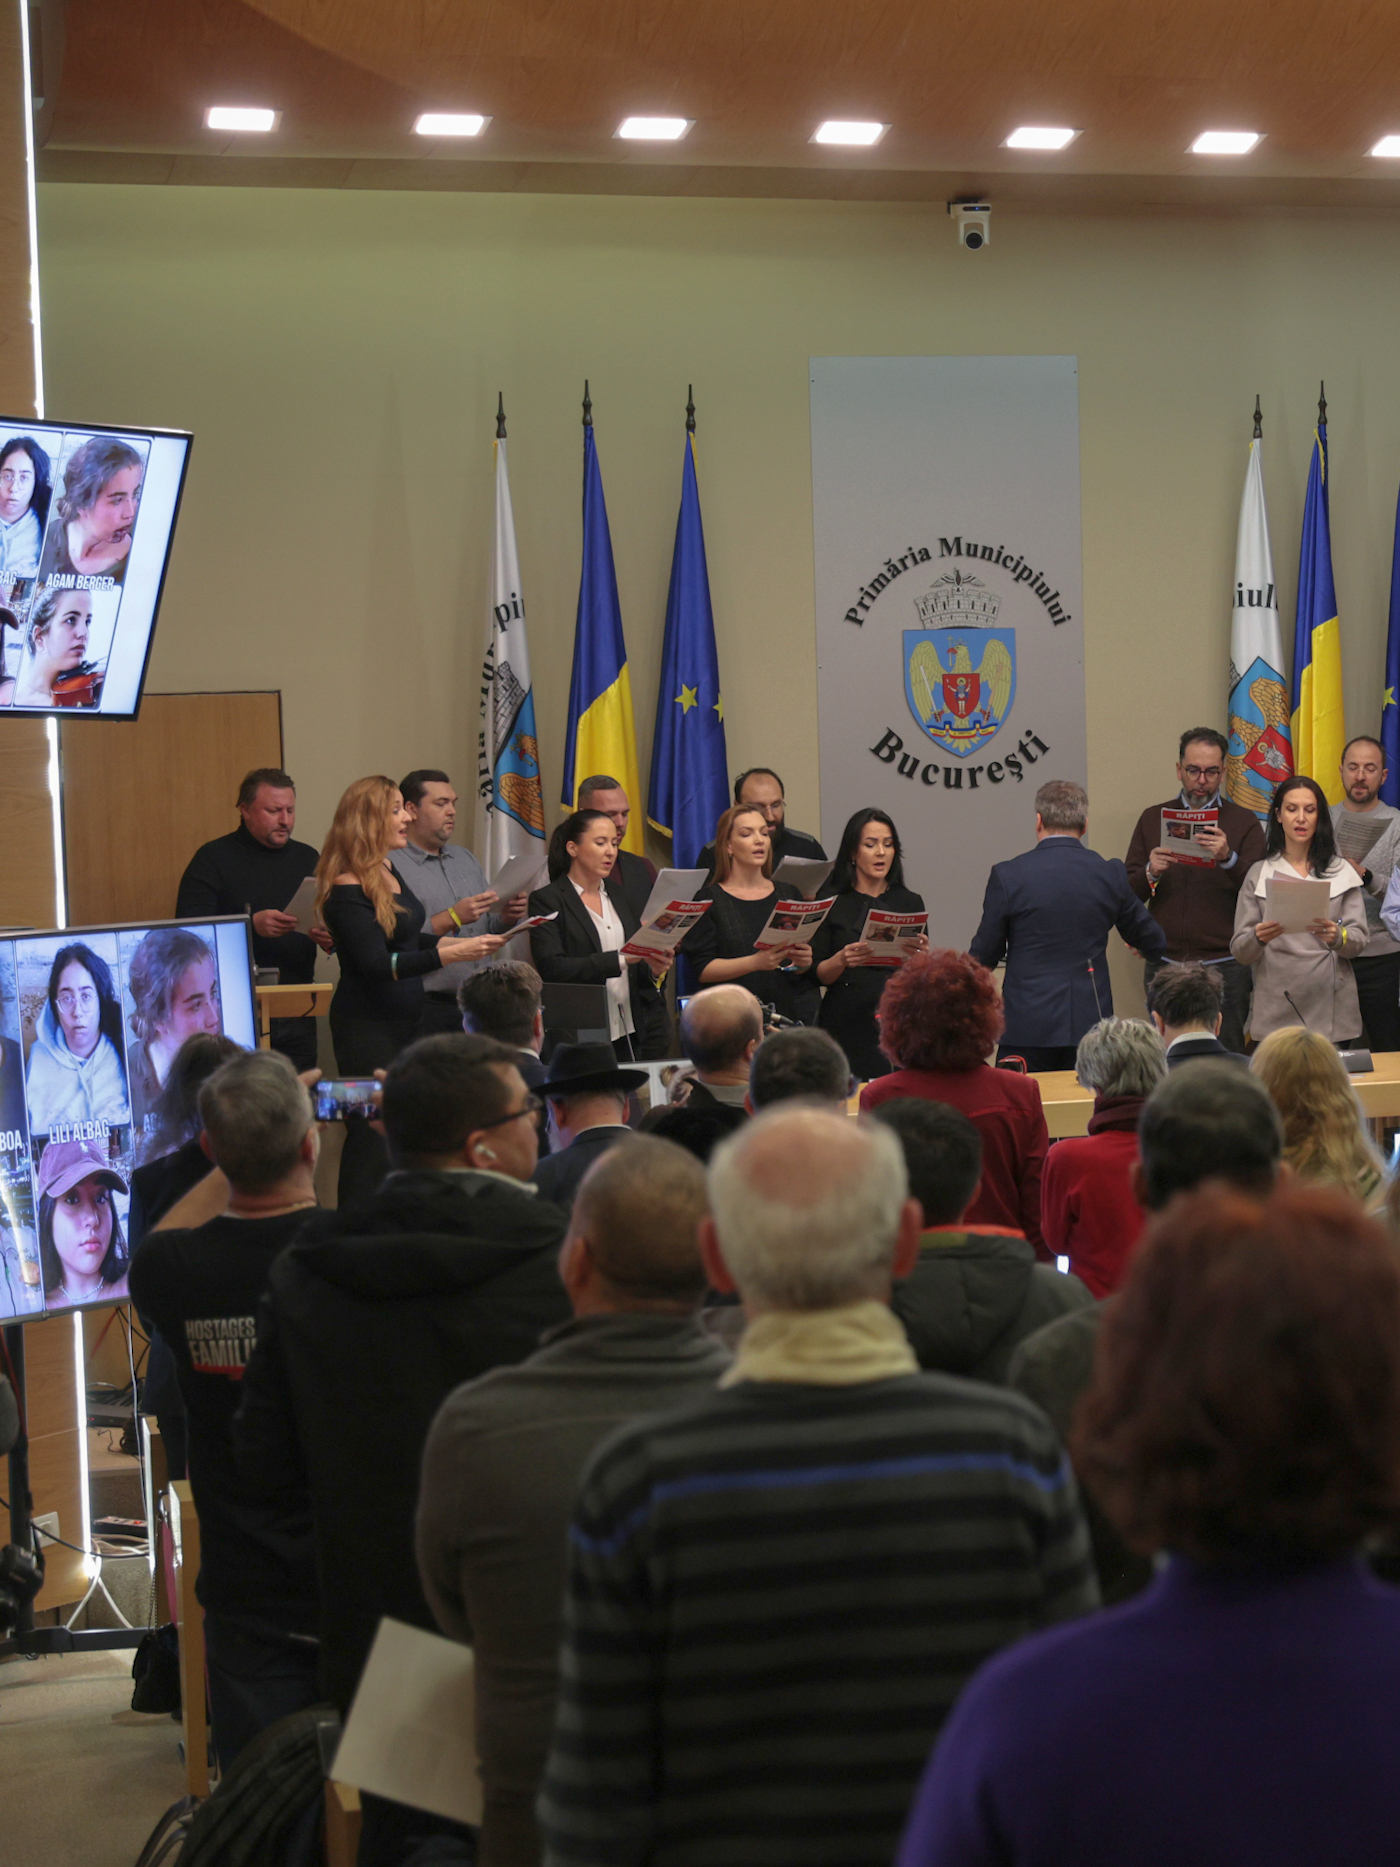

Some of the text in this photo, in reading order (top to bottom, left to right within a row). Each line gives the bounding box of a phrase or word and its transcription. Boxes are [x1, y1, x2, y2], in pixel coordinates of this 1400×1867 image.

[45, 573, 115, 591] AGAM BERGER
[844, 536, 1072, 628] Primăria Municipiului
[1233, 582, 1278, 611] iul
[49, 1118, 110, 1145] LILI ALBAG
[185, 1316, 256, 1340] HOSTAGES
[189, 1338, 257, 1367] FAMILI
